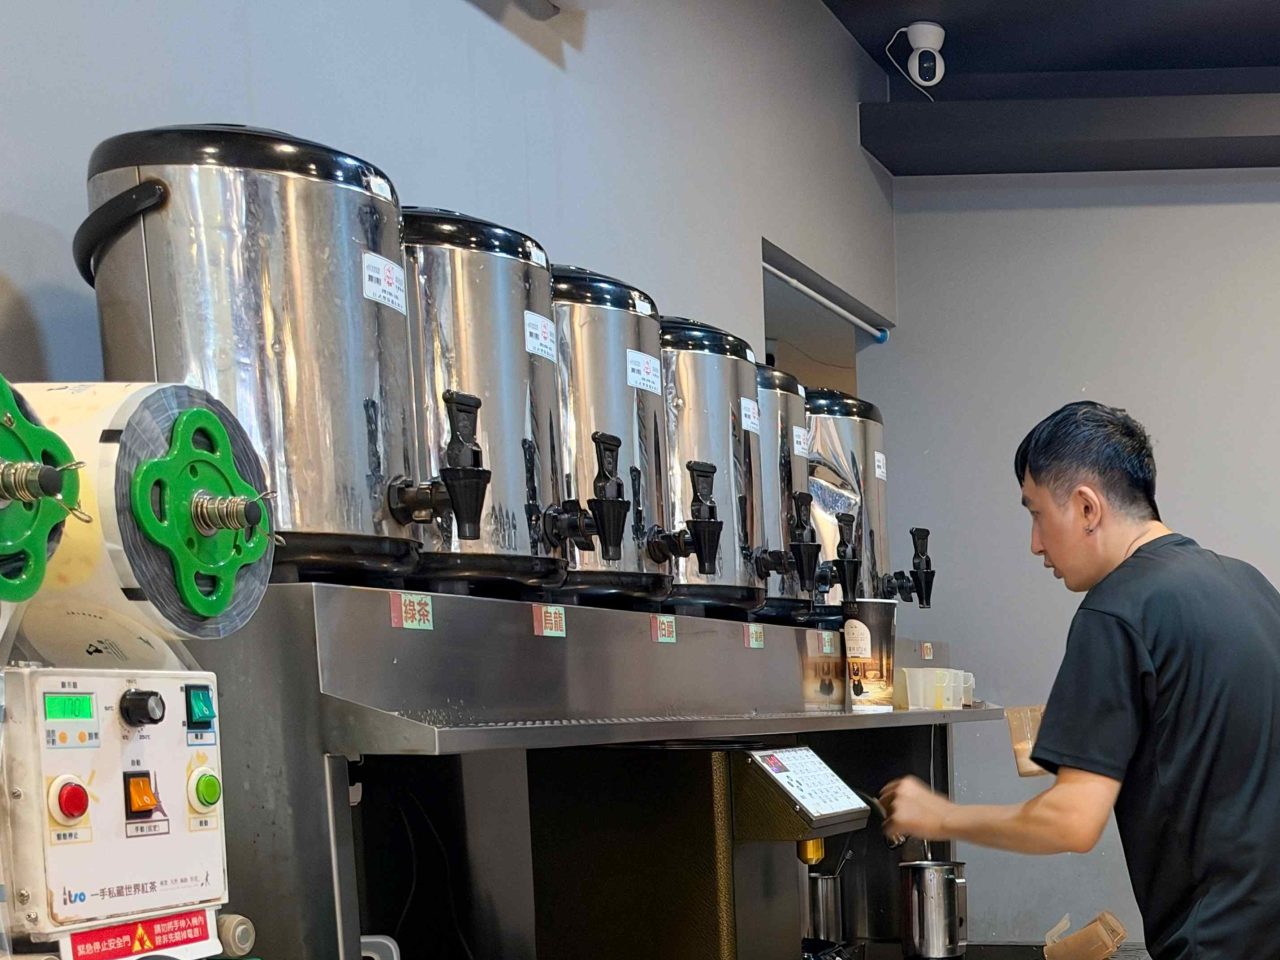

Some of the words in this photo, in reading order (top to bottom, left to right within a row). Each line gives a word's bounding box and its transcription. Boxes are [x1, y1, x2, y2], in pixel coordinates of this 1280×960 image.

[402, 598, 430, 626] 綠茶
[543, 610, 565, 633] 烏龍
[76, 934, 132, 957] 緊急停止安全門
